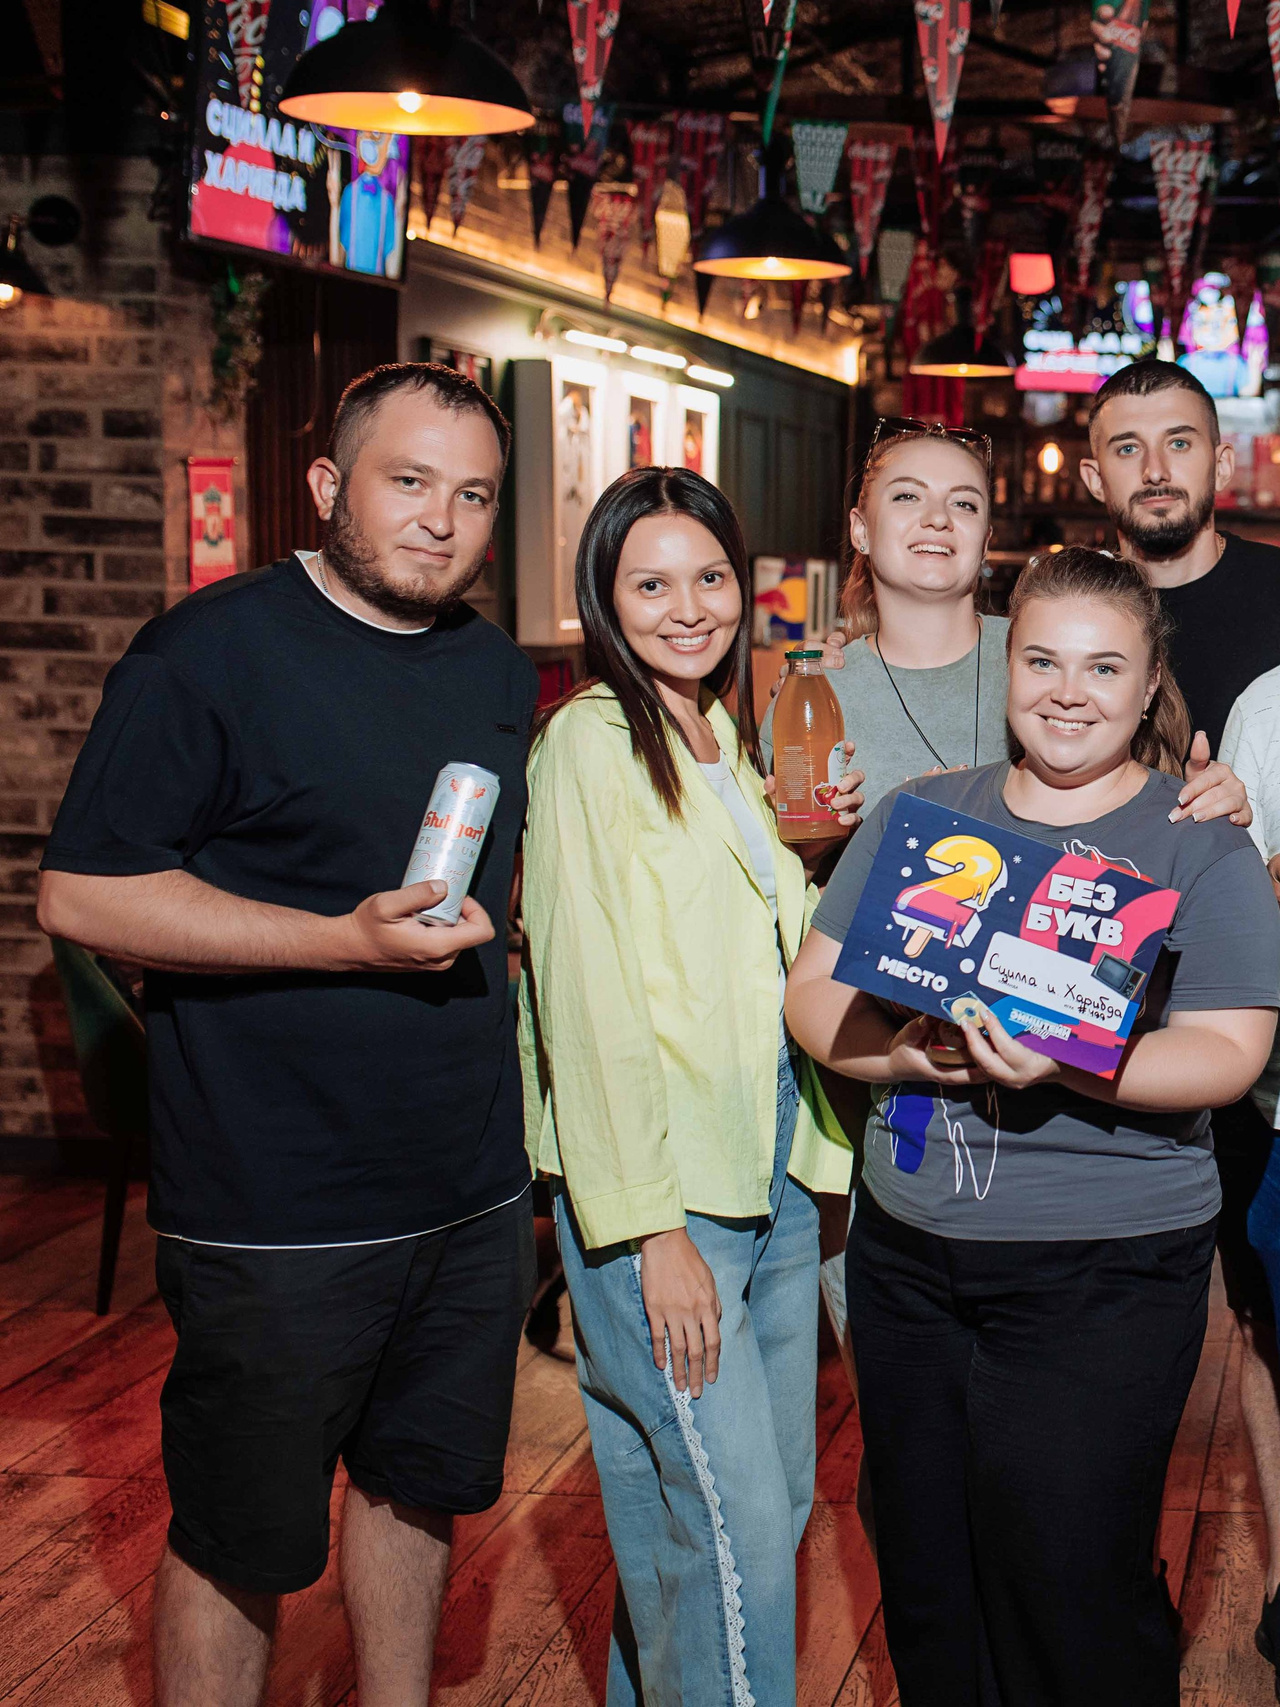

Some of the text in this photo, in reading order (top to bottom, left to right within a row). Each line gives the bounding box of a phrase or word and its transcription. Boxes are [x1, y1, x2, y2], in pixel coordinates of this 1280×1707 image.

[1047, 873, 1117, 911] БЕЗ
[1026, 902, 1124, 946] БУКВ
[876, 955, 949, 992] МЕСТО
[989, 952, 1122, 1019] Сцилла и Харибда
